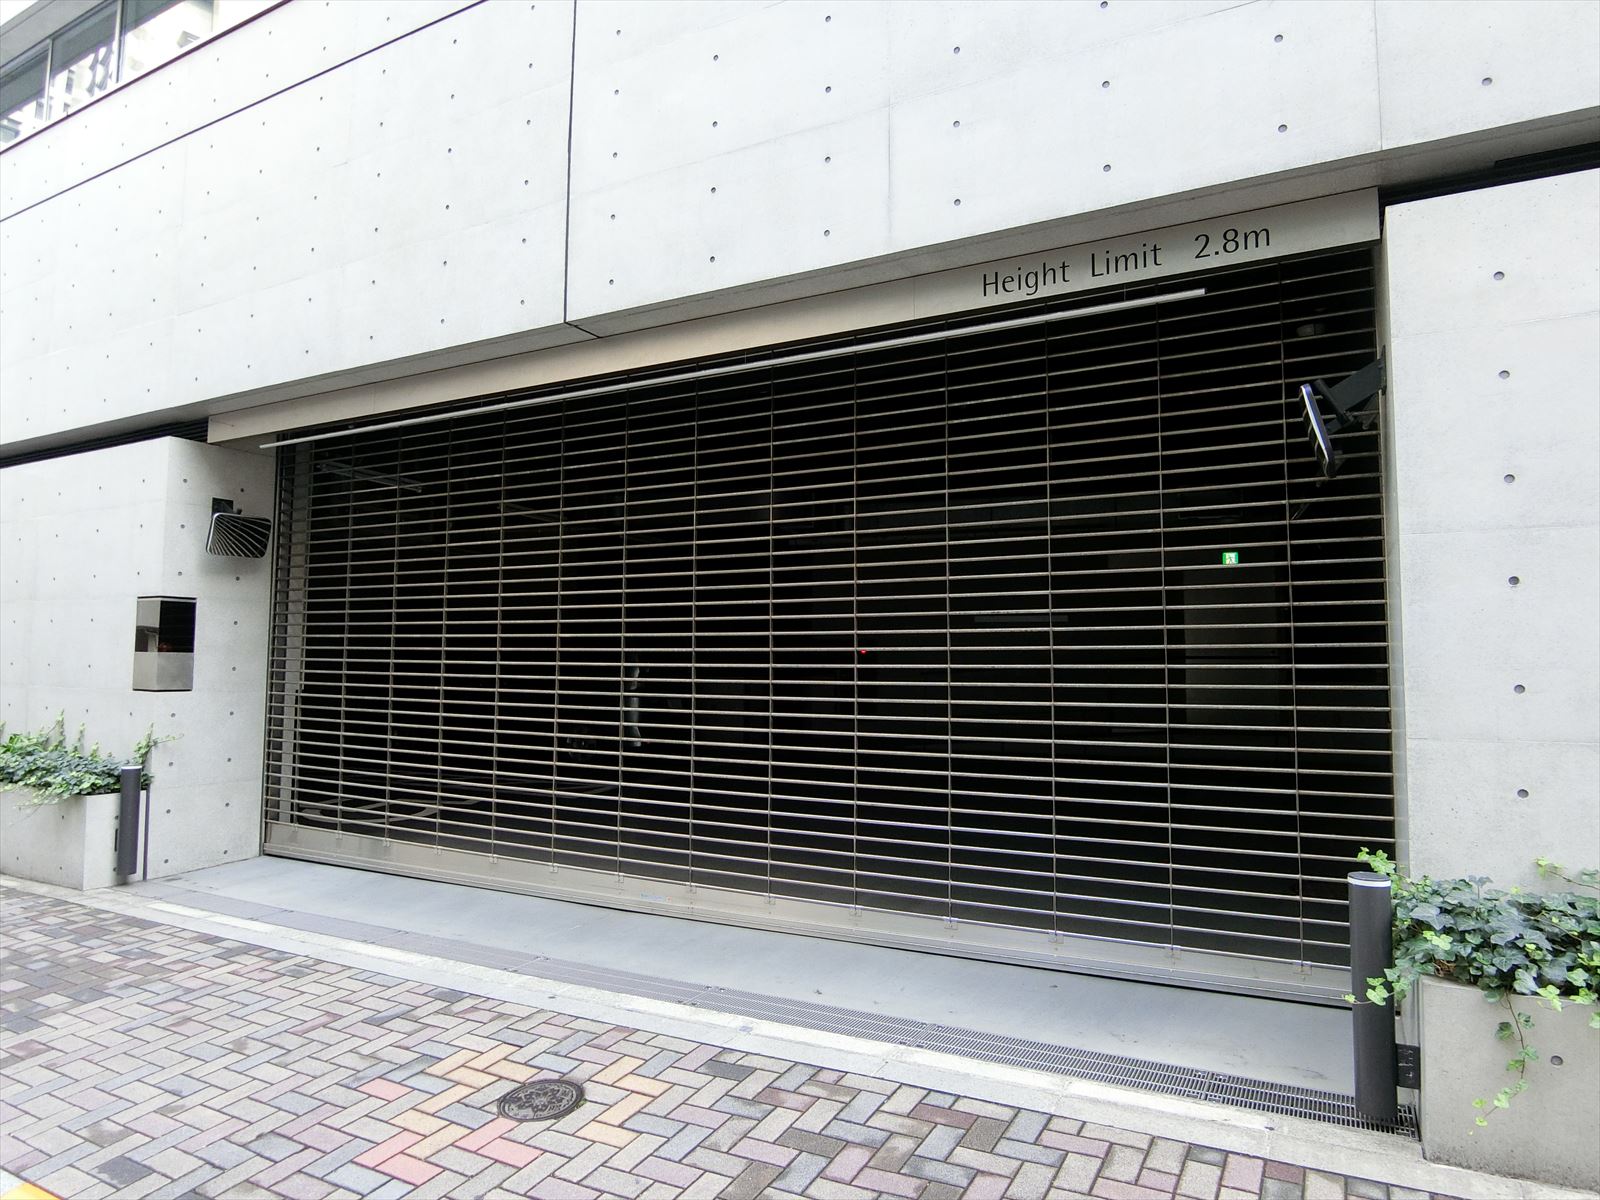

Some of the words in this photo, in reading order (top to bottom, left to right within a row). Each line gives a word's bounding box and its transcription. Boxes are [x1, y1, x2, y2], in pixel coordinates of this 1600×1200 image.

[982, 260, 1070, 296] Height
[1090, 243, 1162, 277] Limit
[1193, 227, 1271, 259] 2.8m
